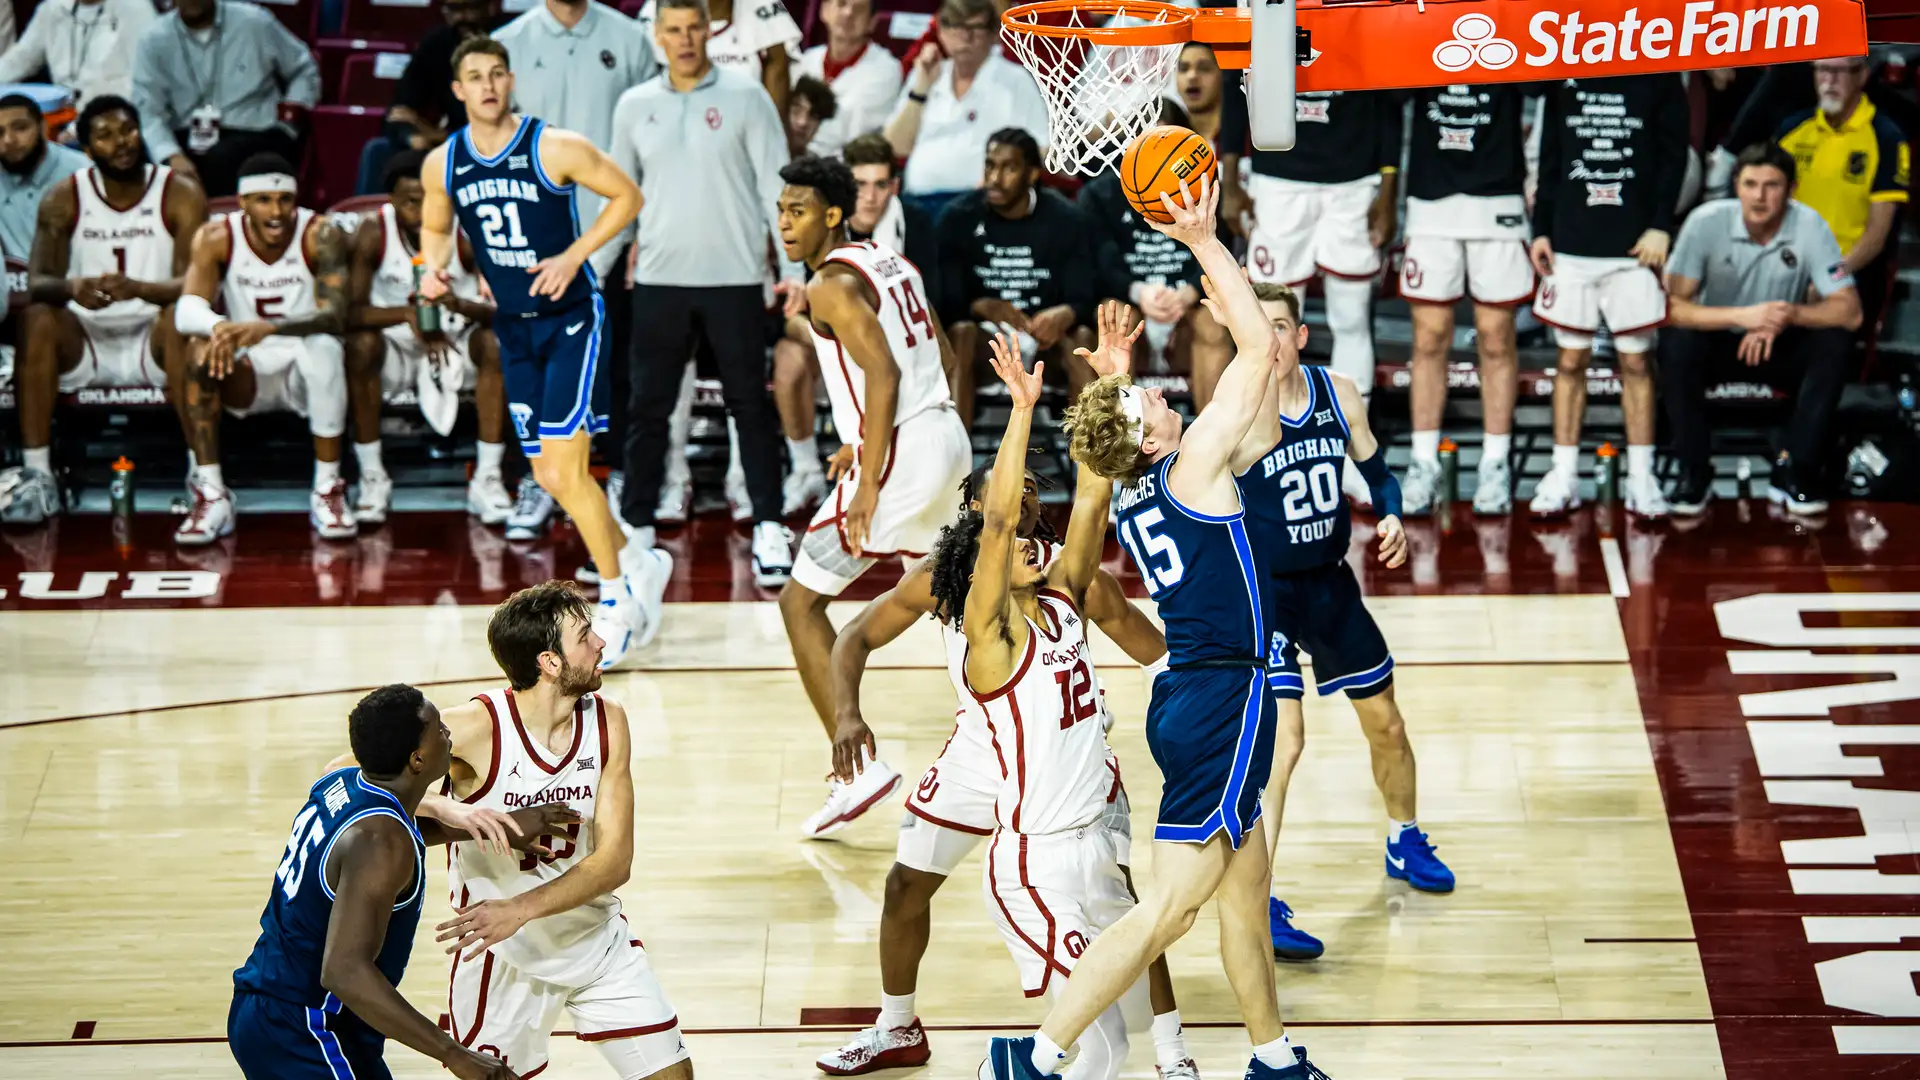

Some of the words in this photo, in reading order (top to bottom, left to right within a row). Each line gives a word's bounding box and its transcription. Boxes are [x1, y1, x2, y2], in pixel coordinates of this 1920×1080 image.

[456, 178, 540, 207] BRIGHAM
[82, 227, 156, 241] OKLAHOMA
[476, 202, 528, 248] 21
[112, 247, 127, 275] 1
[887, 277, 934, 348] 14
[78, 388, 166, 404] OKLAHOMA
[1262, 437, 1346, 479] BRIGHAM
[1279, 461, 1340, 522] 20
[1120, 506, 1185, 597] 15
[1053, 658, 1098, 731] 12
[503, 785, 593, 808] OKLAHOMA
[276, 803, 327, 902] 45
